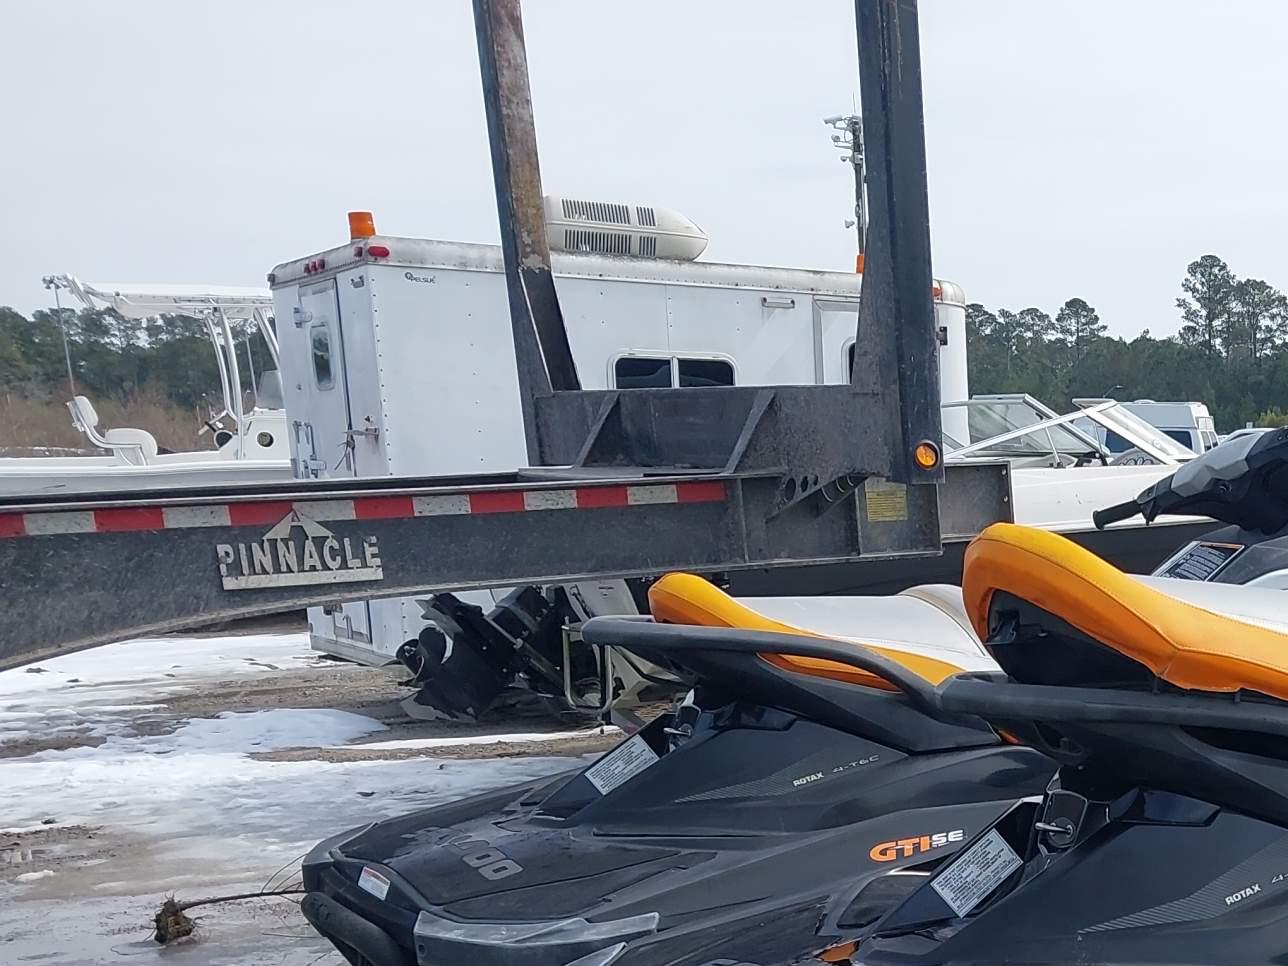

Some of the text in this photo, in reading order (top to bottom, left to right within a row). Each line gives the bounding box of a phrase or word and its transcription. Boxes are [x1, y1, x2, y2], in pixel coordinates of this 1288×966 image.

[216, 535, 382, 577] PINNACLE
[792, 771, 825, 787] ROTAX
[1224, 883, 1262, 905] ROTAX
